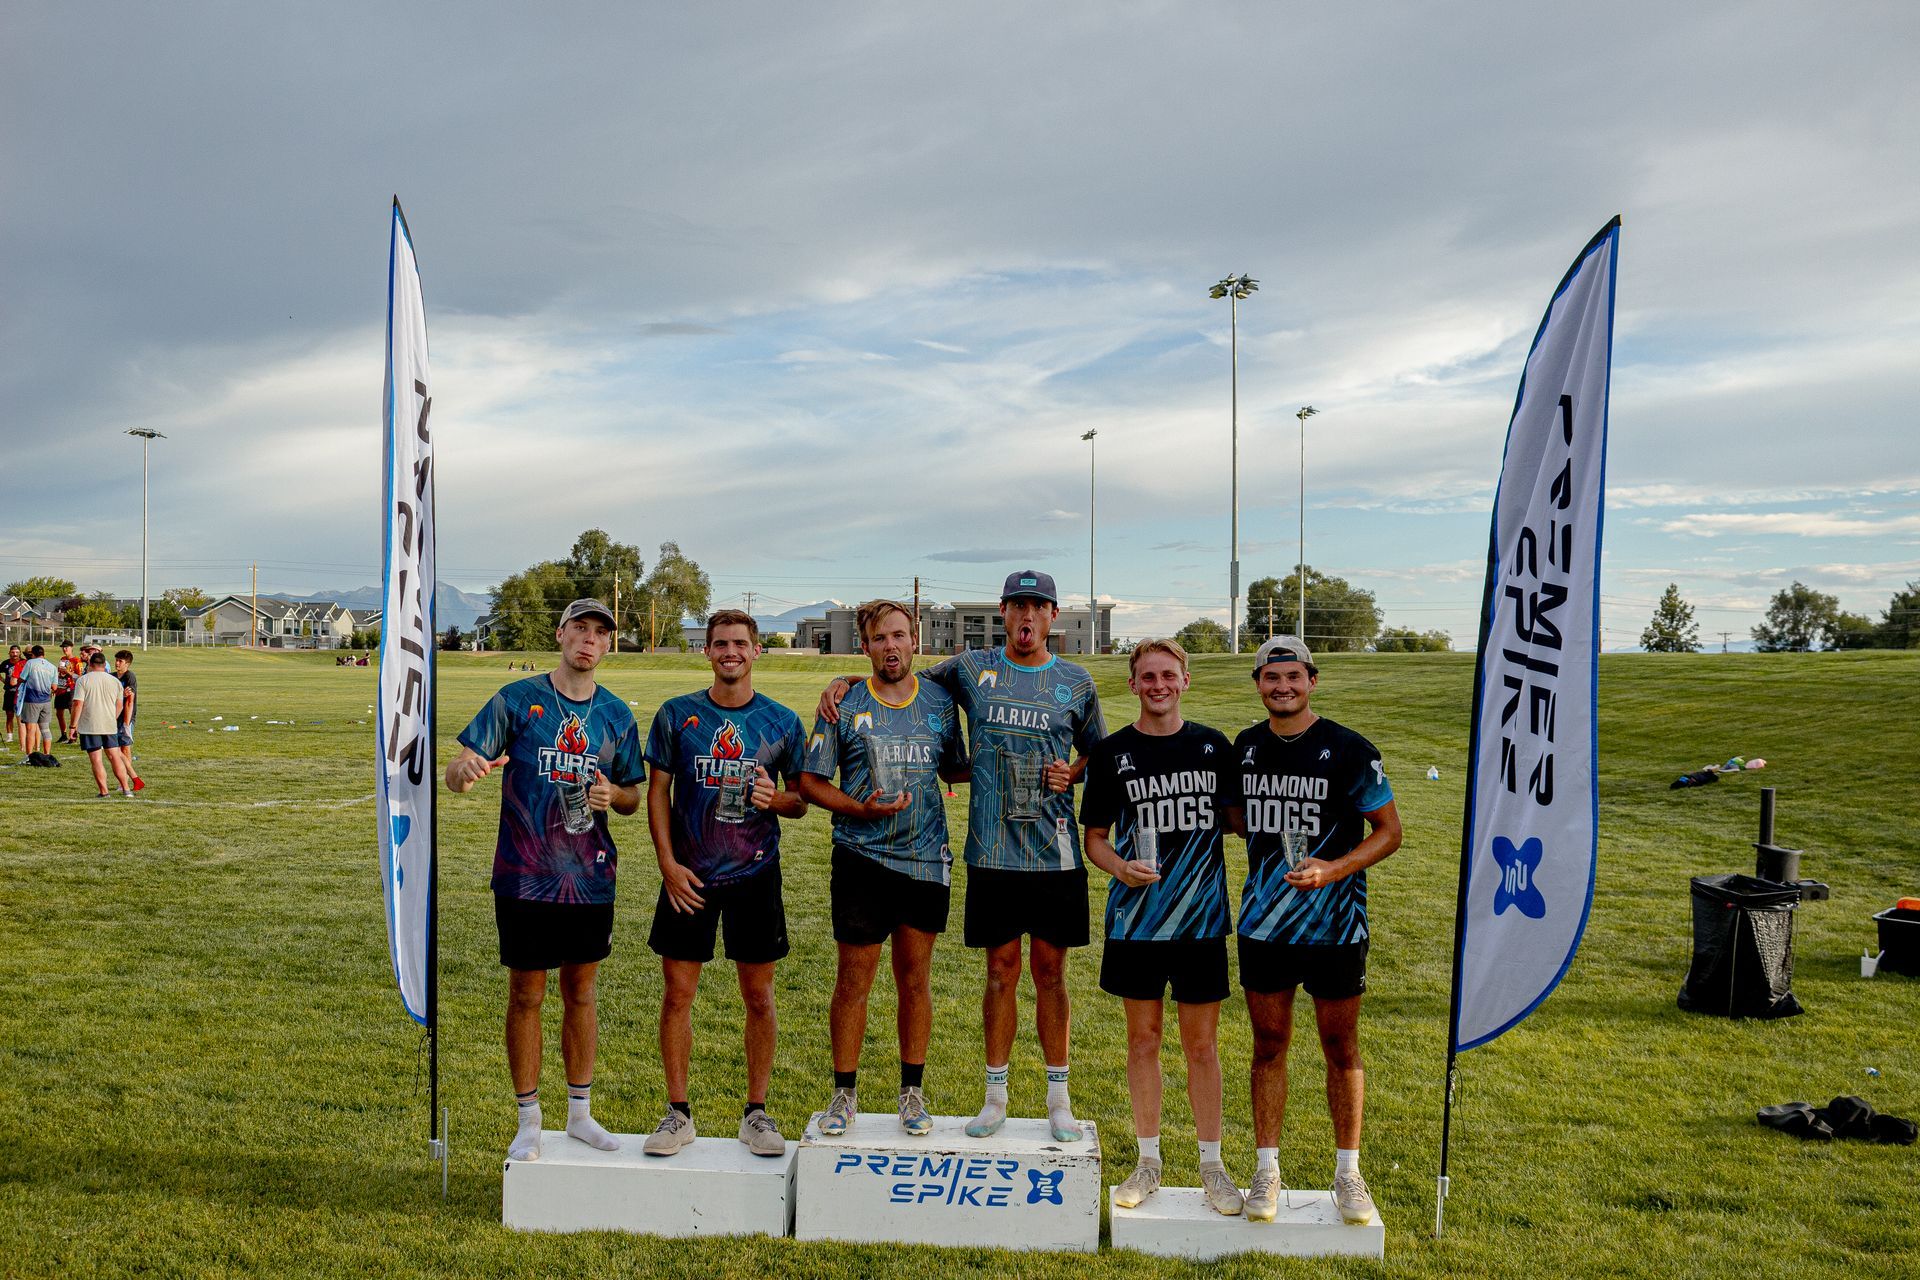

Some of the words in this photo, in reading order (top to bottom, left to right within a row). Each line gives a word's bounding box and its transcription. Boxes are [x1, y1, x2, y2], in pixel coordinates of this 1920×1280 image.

[986, 705, 1051, 731] J.A.R.V.I.S.
[541, 750, 597, 776] TURF
[1125, 770, 1217, 802] DIAMOND
[1242, 774, 1329, 800] DIAMOND
[1136, 795, 1215, 833] DOGS
[1246, 798, 1321, 837] DOGS
[834, 1153, 1020, 1181] PREMIER
[889, 1182, 1014, 1207] SPIKE
